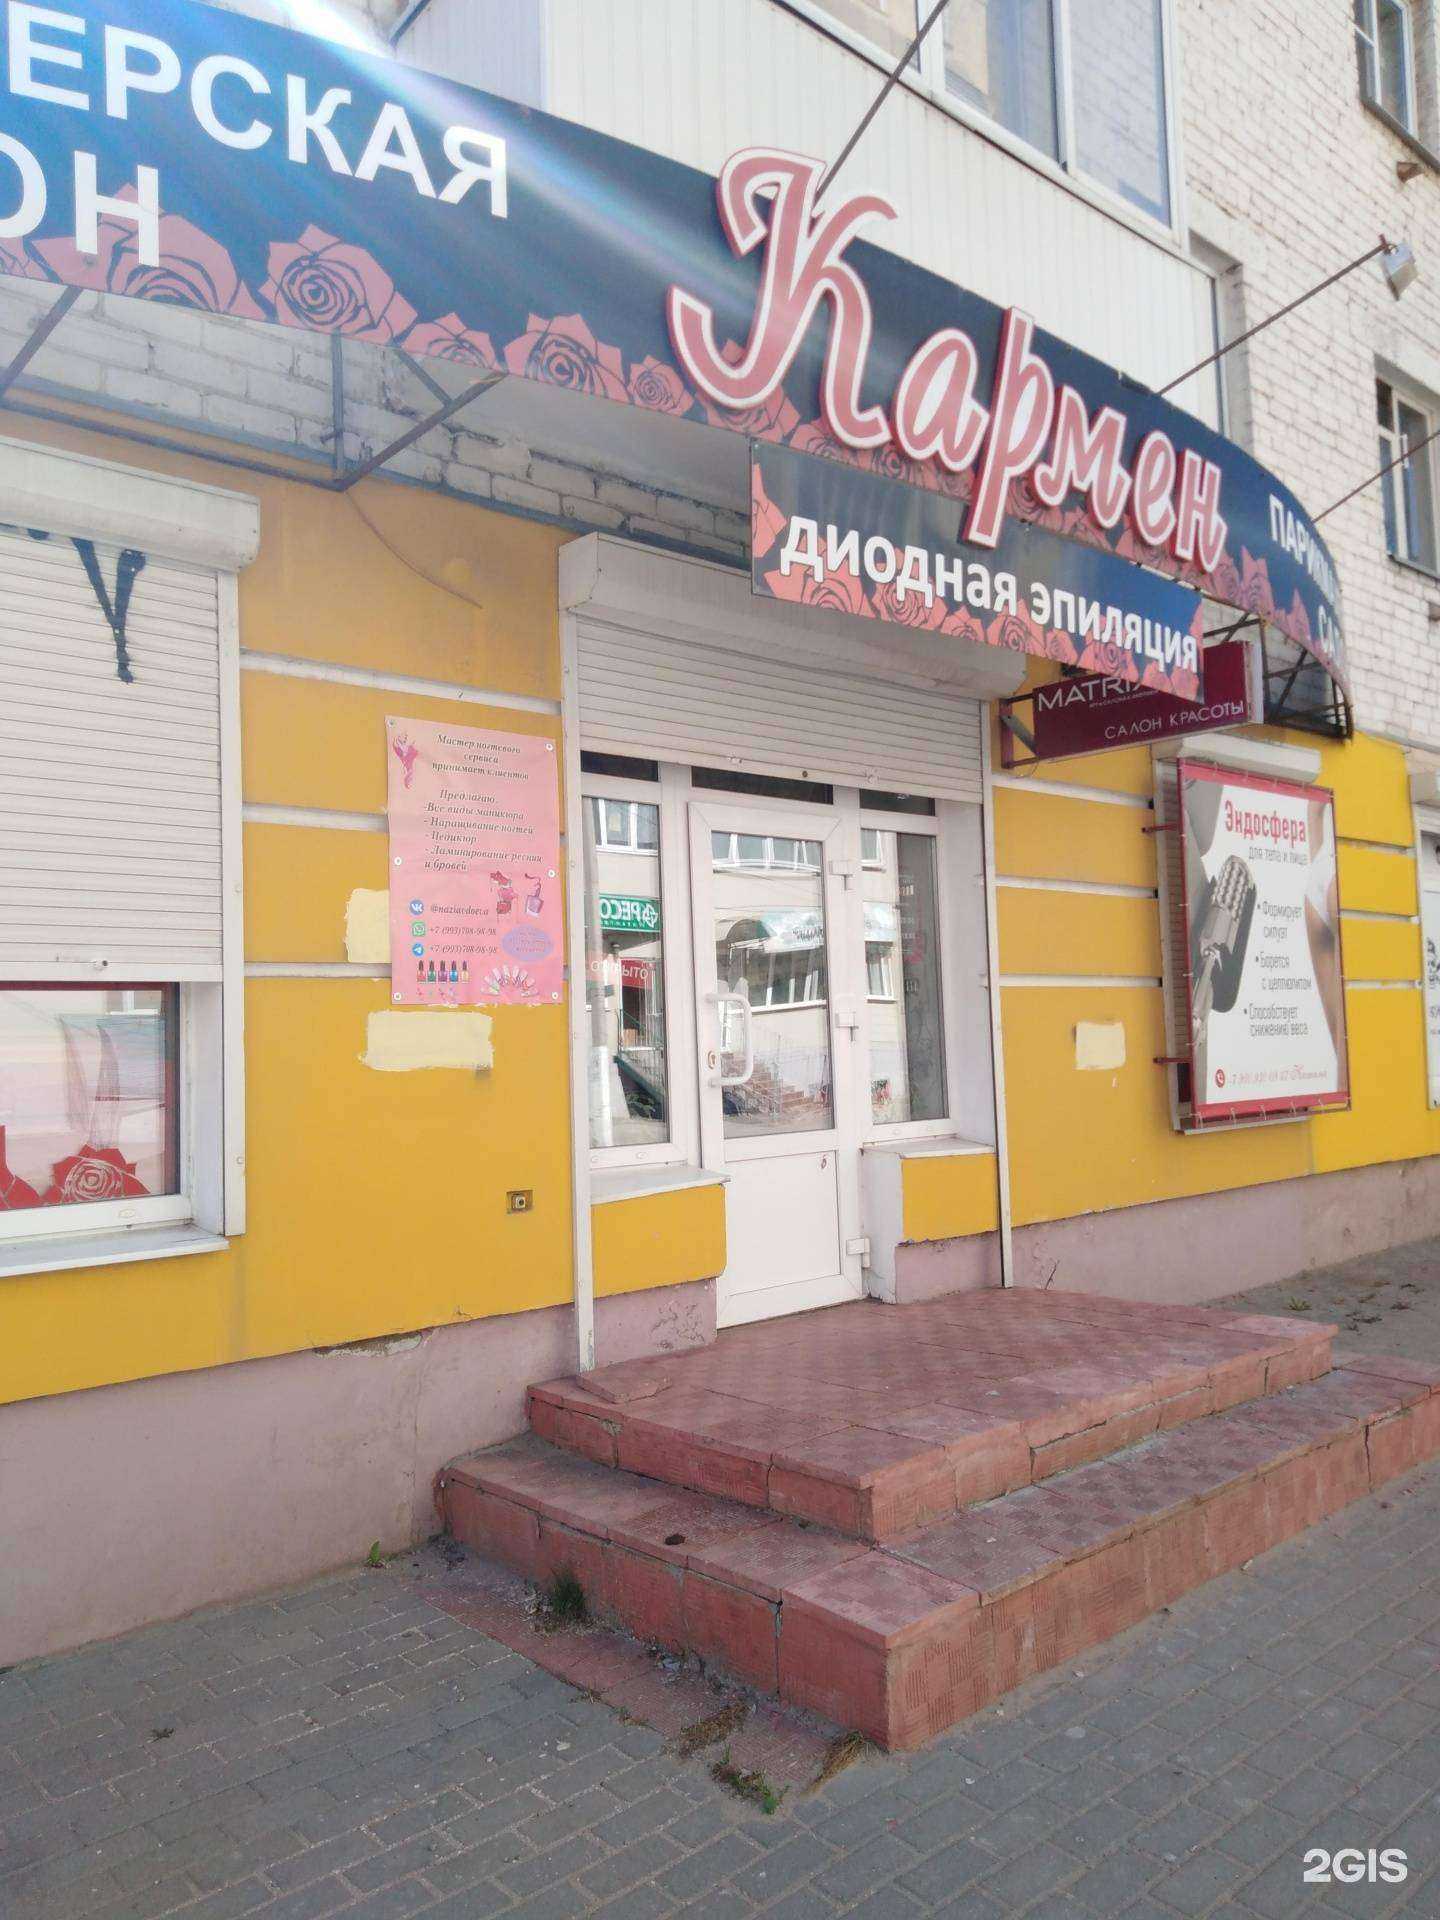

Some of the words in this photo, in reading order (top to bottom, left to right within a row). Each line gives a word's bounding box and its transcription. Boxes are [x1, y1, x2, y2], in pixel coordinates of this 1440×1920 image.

[667, 146, 1228, 574] Кармен
[1104, 717, 1162, 740] САЛОН
[1169, 699, 1244, 727] КРАСОТЫ
[437, 734, 475, 749] Мастер
[476, 741, 521, 754] ногтевого
[463, 753, 499, 764] сервиса
[432, 762, 486, 775] принимает
[487, 768, 529, 780] клиентов
[447, 805, 474, 815] виды
[475, 808, 524, 822] маникюра
[430, 816, 501, 832] Наращивание
[1224, 799, 1307, 849] Эндосфера
[431, 830, 477, 846] Педикюр
[430, 845, 508, 861] Ламинирование
[432, 859, 468, 872] бровей
